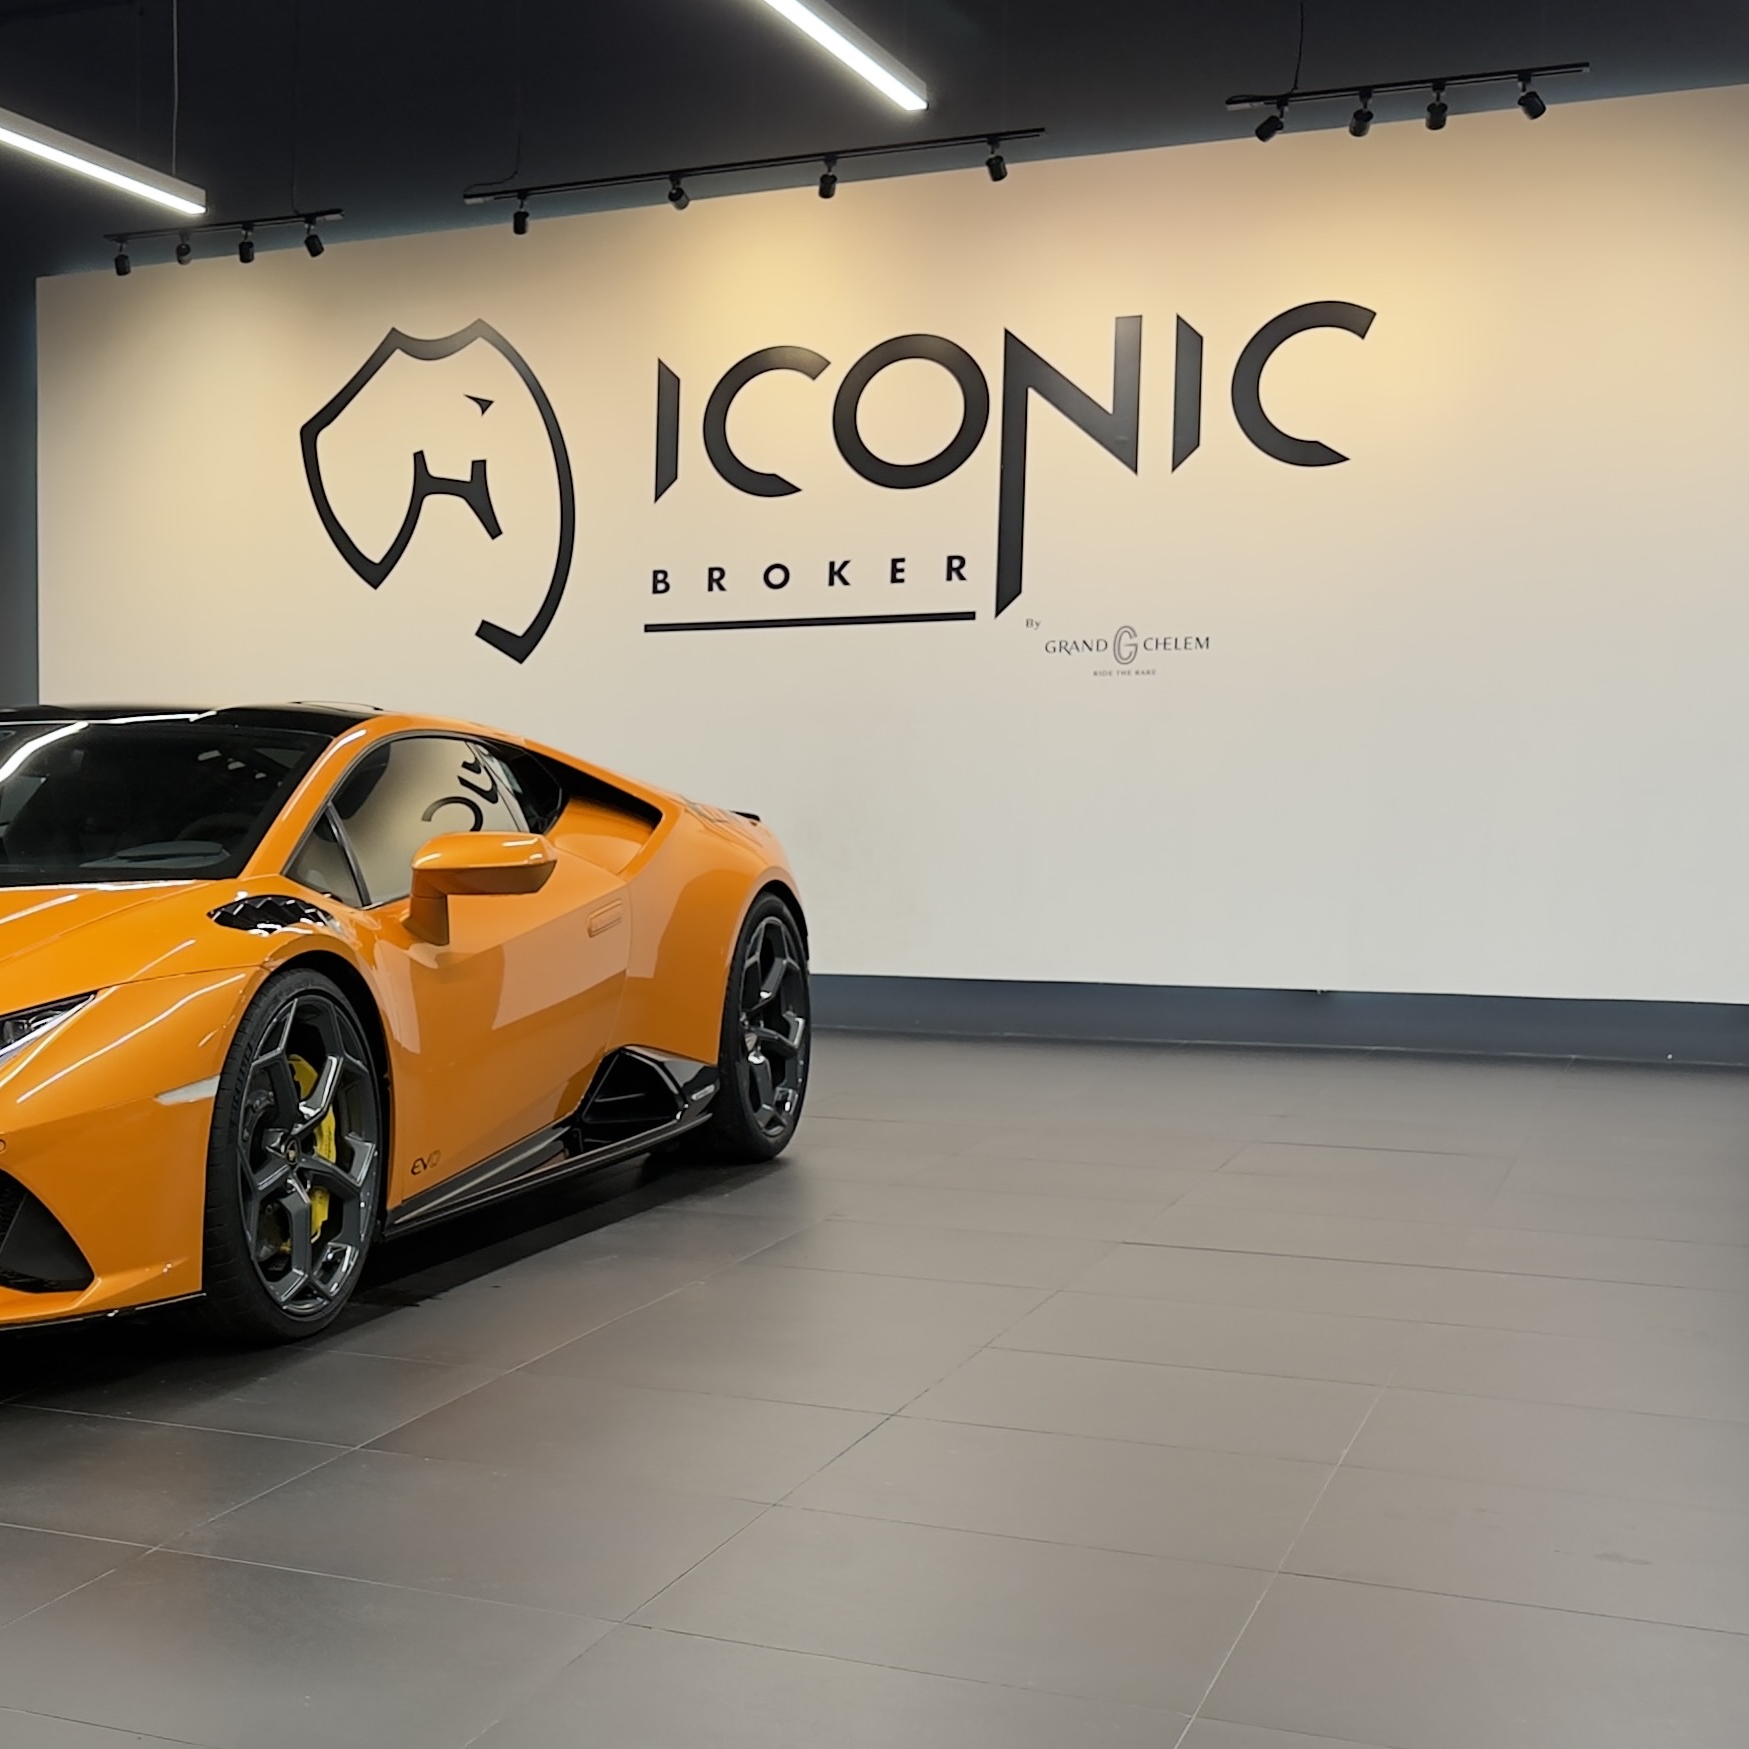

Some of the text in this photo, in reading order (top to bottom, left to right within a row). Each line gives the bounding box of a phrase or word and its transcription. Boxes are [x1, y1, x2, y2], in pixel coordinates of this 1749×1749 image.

[653, 300, 1378, 619] ICONIC
[652, 555, 968, 596] BROKER
[1025, 618, 1042, 630] By
[1044, 639, 1108, 656] GRAND
[1143, 636, 1211, 652] CHELEM
